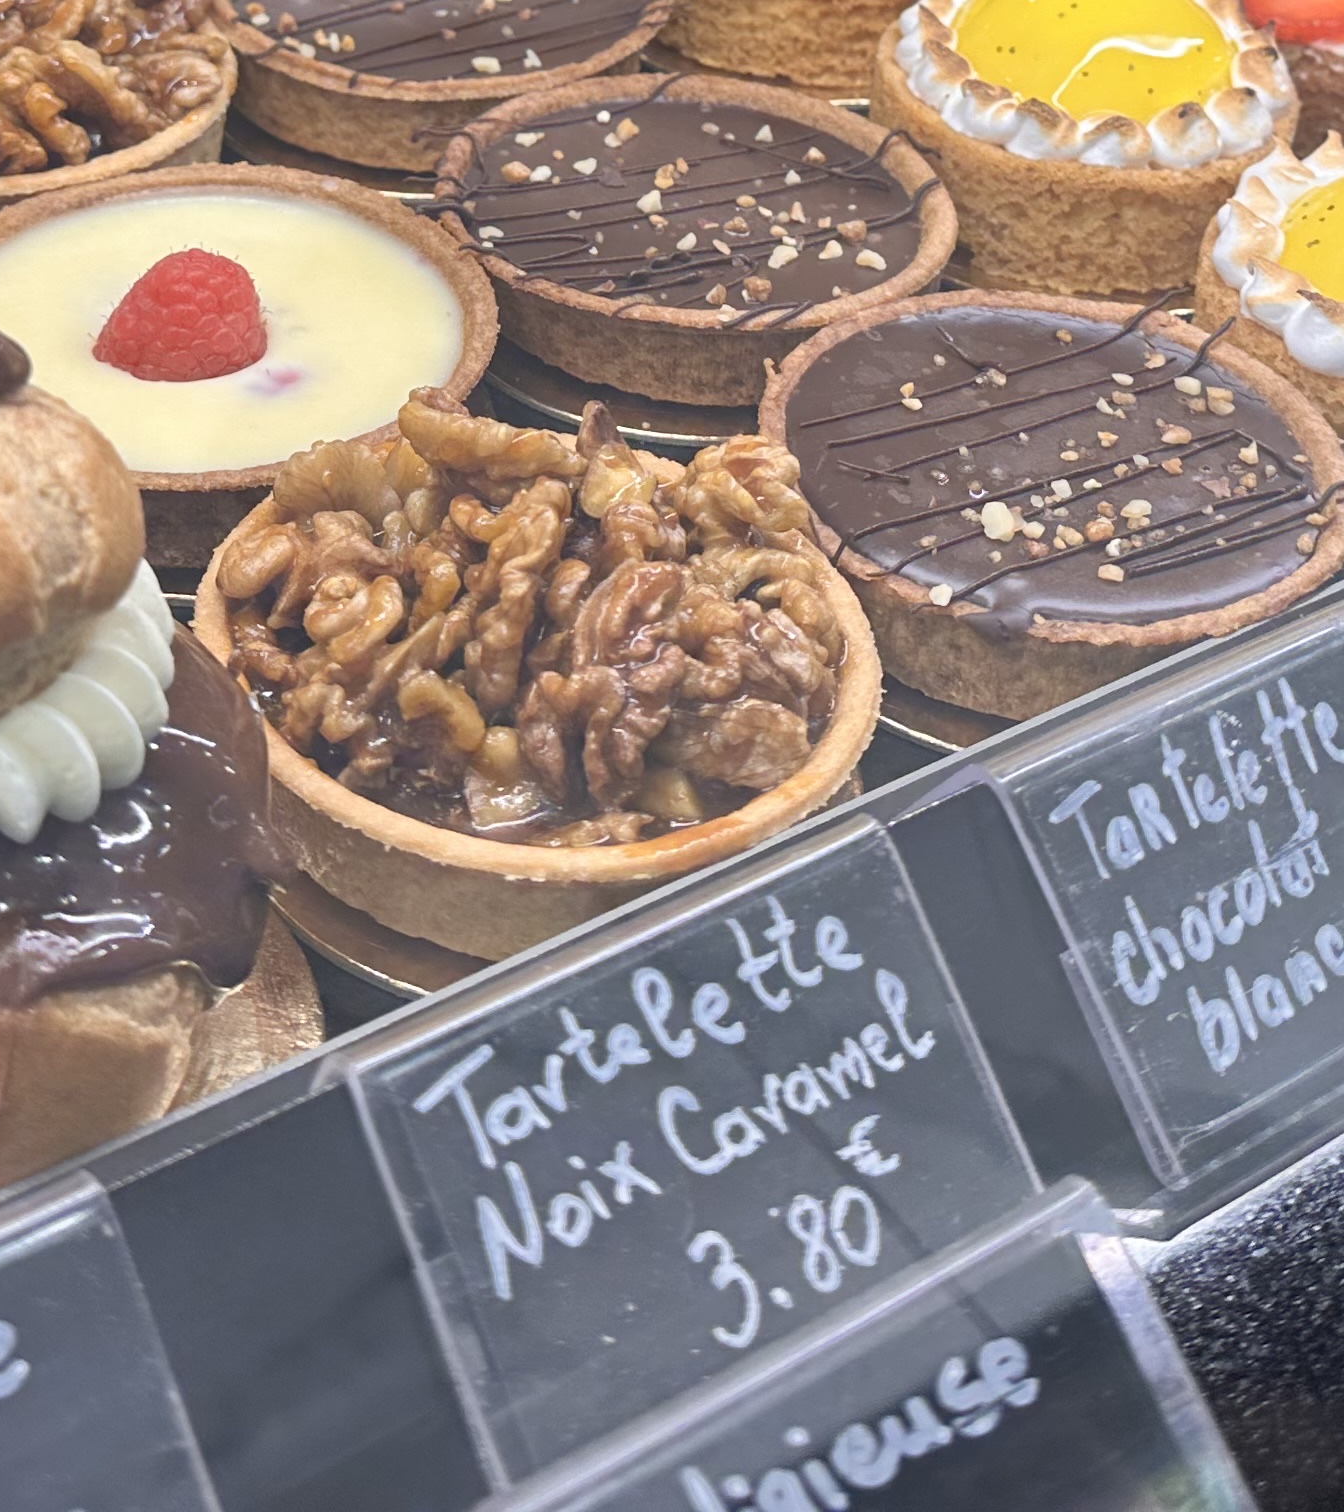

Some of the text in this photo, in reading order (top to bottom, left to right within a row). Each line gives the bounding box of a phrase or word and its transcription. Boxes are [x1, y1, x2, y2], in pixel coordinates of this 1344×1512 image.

[413, 893, 864, 1169] Tartelette
[477, 967, 936, 1300] Noix Caramel
